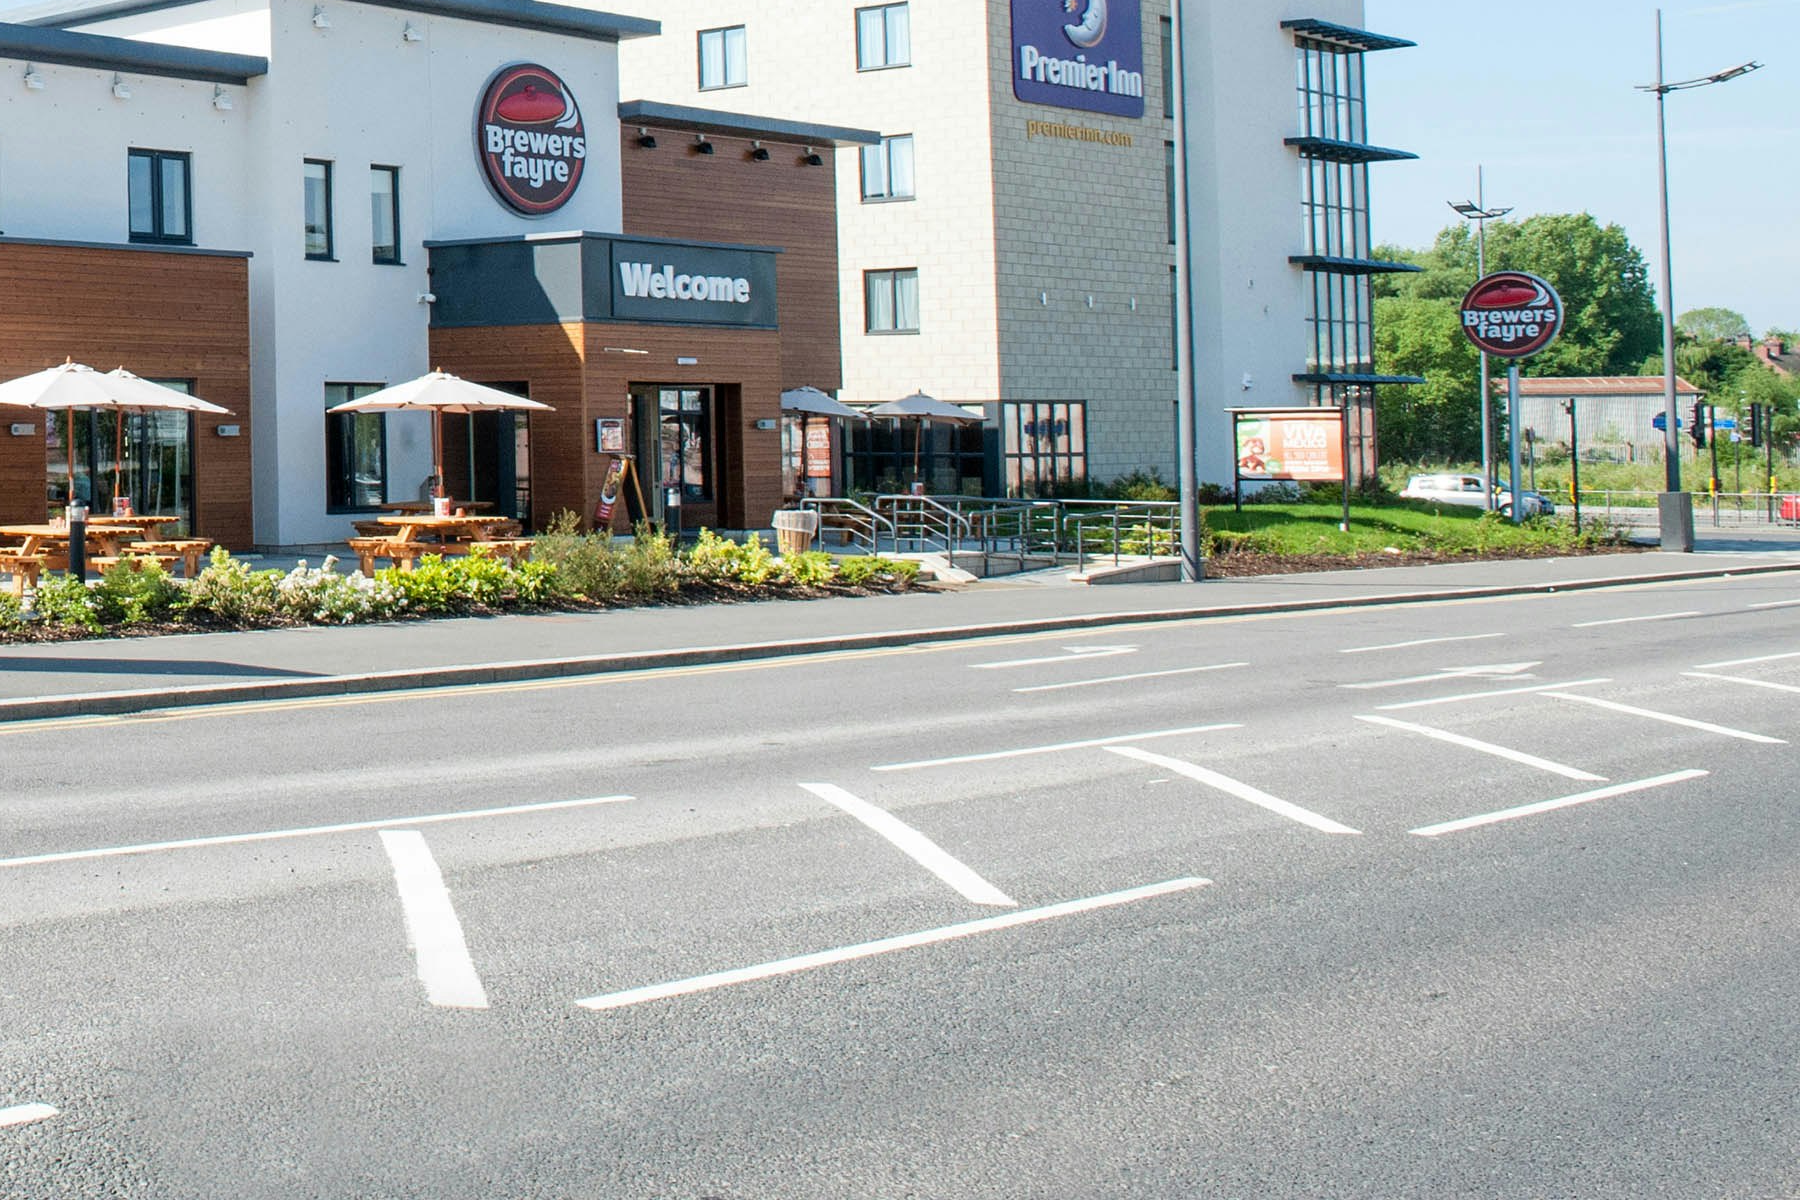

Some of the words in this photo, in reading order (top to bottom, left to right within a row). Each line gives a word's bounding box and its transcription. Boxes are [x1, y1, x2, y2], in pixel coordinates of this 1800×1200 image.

[1020, 45, 1109, 91] Premier
[1108, 60, 1143, 98] Inn
[486, 125, 586, 159] Brewers
[1027, 120, 1133, 148] premierinn.com
[502, 147, 569, 188] fayre
[619, 262, 751, 303] Welcome
[1462, 308, 1556, 326] Brewers
